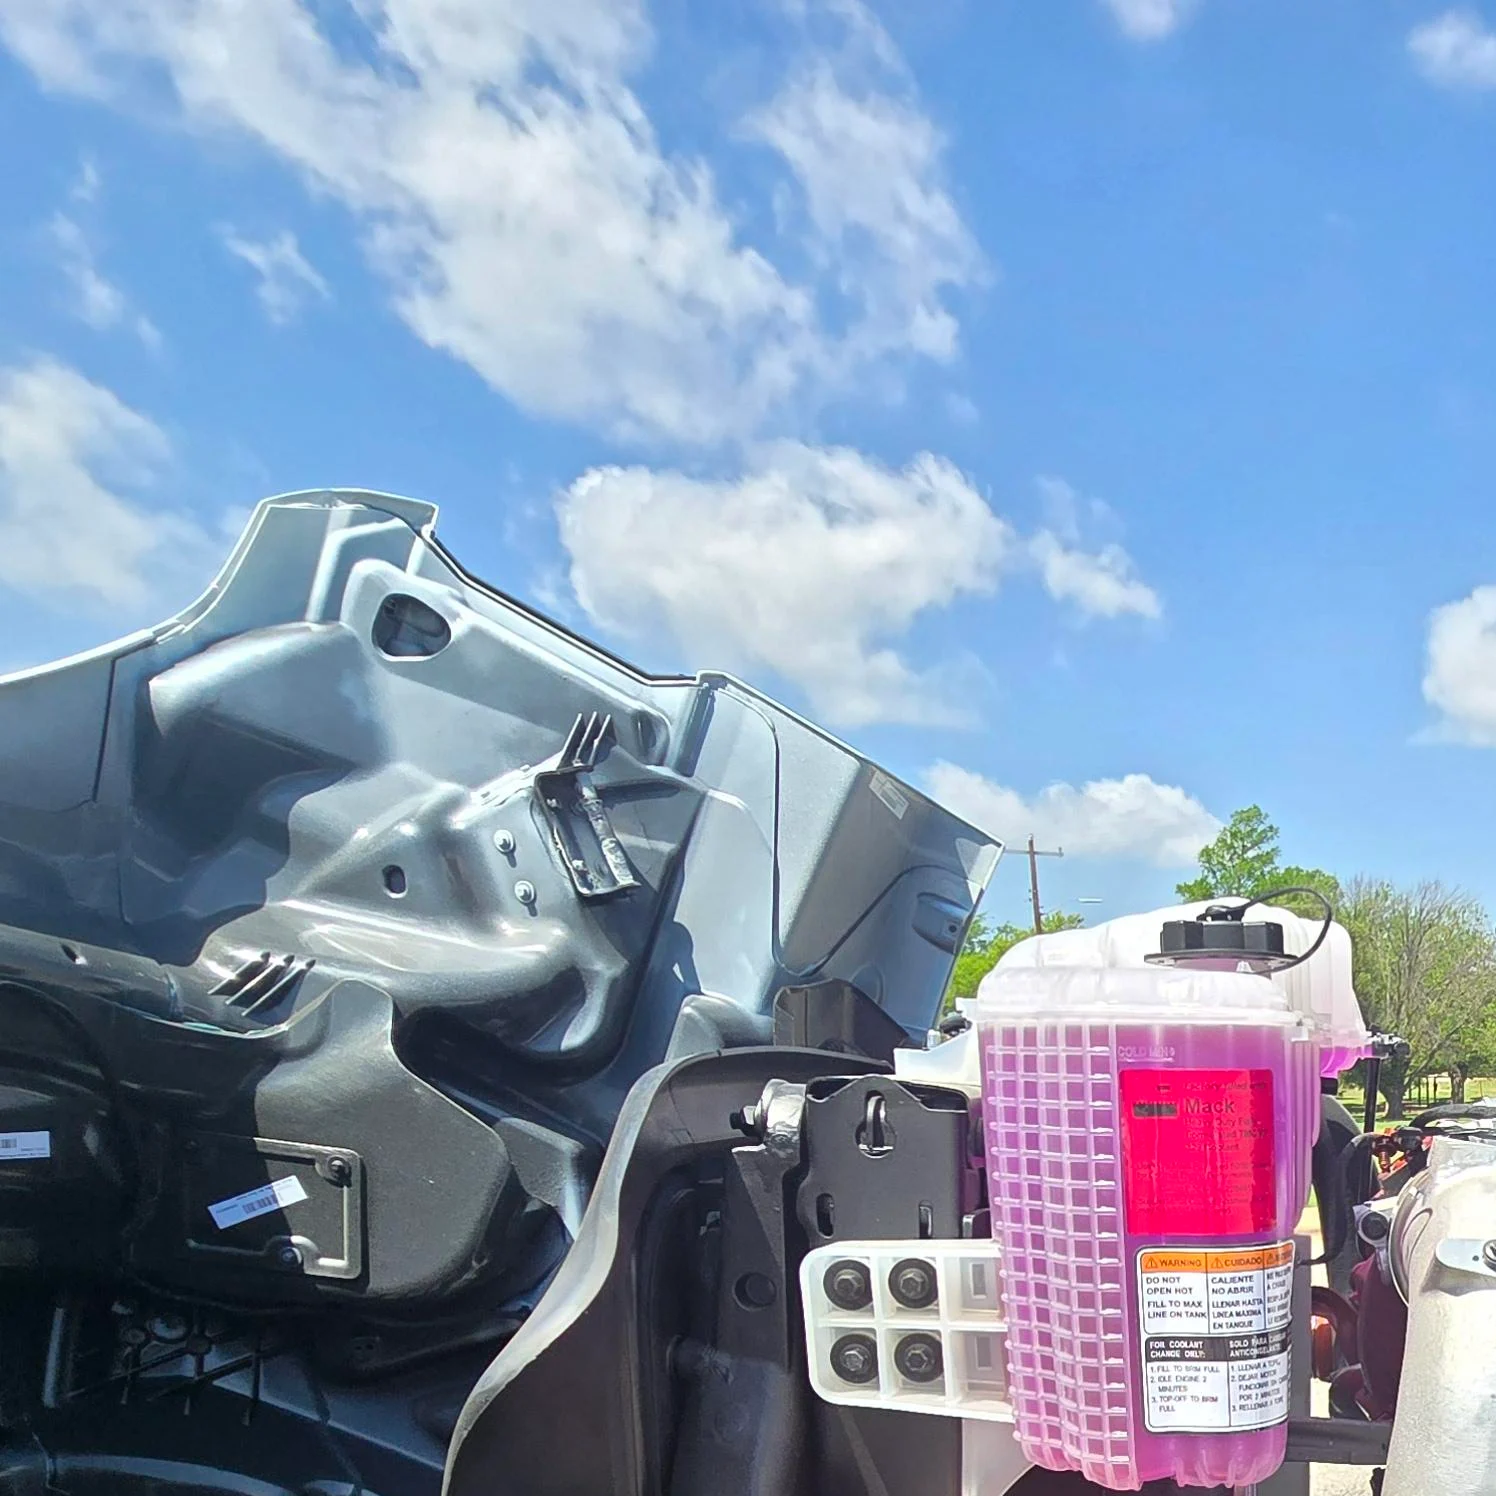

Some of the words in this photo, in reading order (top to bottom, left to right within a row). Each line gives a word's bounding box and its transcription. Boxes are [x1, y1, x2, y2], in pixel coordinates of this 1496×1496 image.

[1184, 1098, 1236, 1114] Mack
[1160, 1259, 1202, 1267] WARNING
[1225, 1256, 1263, 1267] CUIDADO
[1211, 1275, 1255, 1284] CALIENTE
[1146, 1287, 1172, 1295] OPEN
[1174, 1287, 1193, 1295] HOT
[1227, 1286, 1254, 1294] ABRIR
[1147, 1300, 1167, 1308] FILL
[1211, 1299, 1241, 1308] LLENAR
[1213, 1322, 1223, 1330] EN
[1225, 1320, 1253, 1329] TANQUE
[1149, 1341, 1165, 1349] FOR
[1169, 1340, 1204, 1349] COOLANT
[1229, 1339, 1248, 1348] SOLO
[1150, 1350, 1181, 1358] CHANGE
